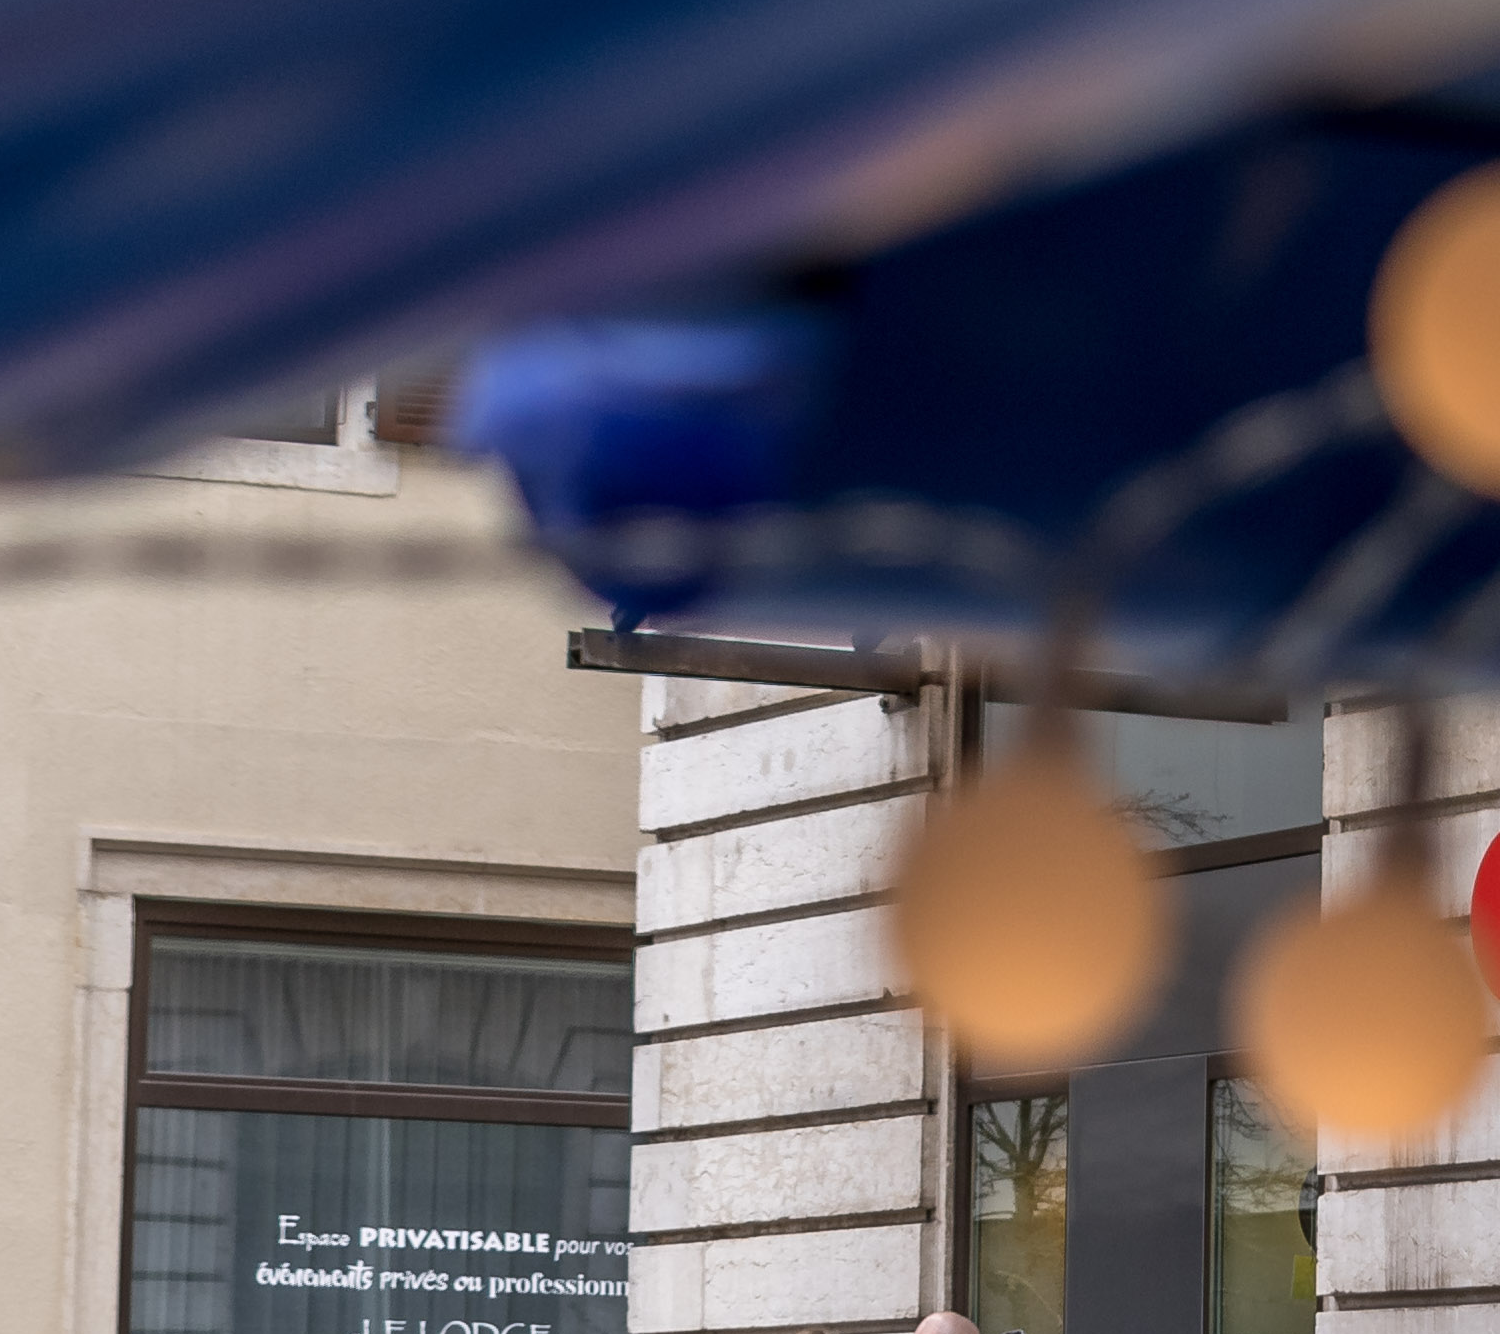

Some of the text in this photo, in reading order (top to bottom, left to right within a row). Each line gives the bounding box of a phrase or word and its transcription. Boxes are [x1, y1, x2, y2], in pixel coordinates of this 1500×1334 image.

[278, 1214, 350, 1251] Espace
[359, 1226, 550, 1254] PRIVATISABLE
[553, 1239, 601, 1262] pour
[379, 1269, 450, 1291] privés
[453, 1274, 484, 1292] ou
